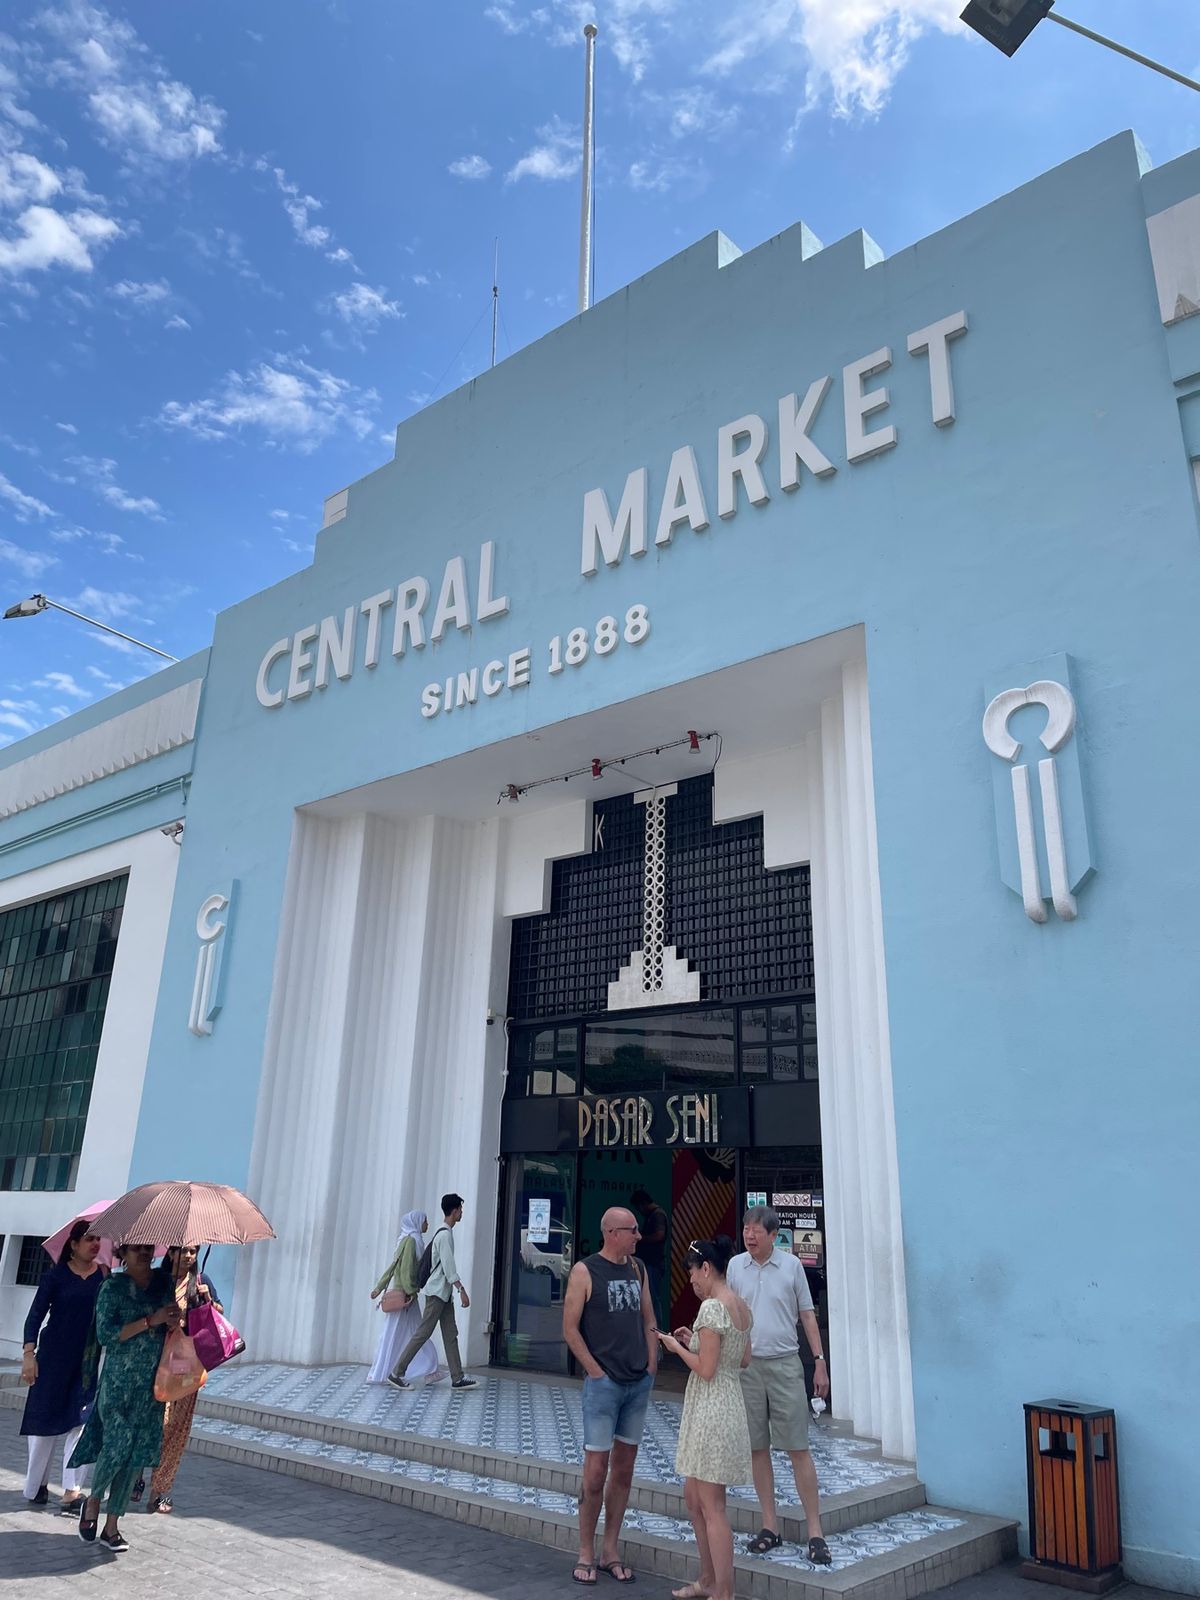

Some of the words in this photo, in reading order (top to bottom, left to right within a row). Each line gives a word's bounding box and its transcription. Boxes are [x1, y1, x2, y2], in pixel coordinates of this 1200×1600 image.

[254, 540, 510, 708] CENTRAL
[580, 310, 968, 578] MARKET
[420, 647, 532, 718] SINCE
[547, 604, 651, 675] 1888
[578, 1096, 654, 1147] PASAR
[665, 1092, 719, 1144] SENI
[527, 1175, 596, 1190] MALAYSAN
[800, 1244, 816, 1252] ATM
